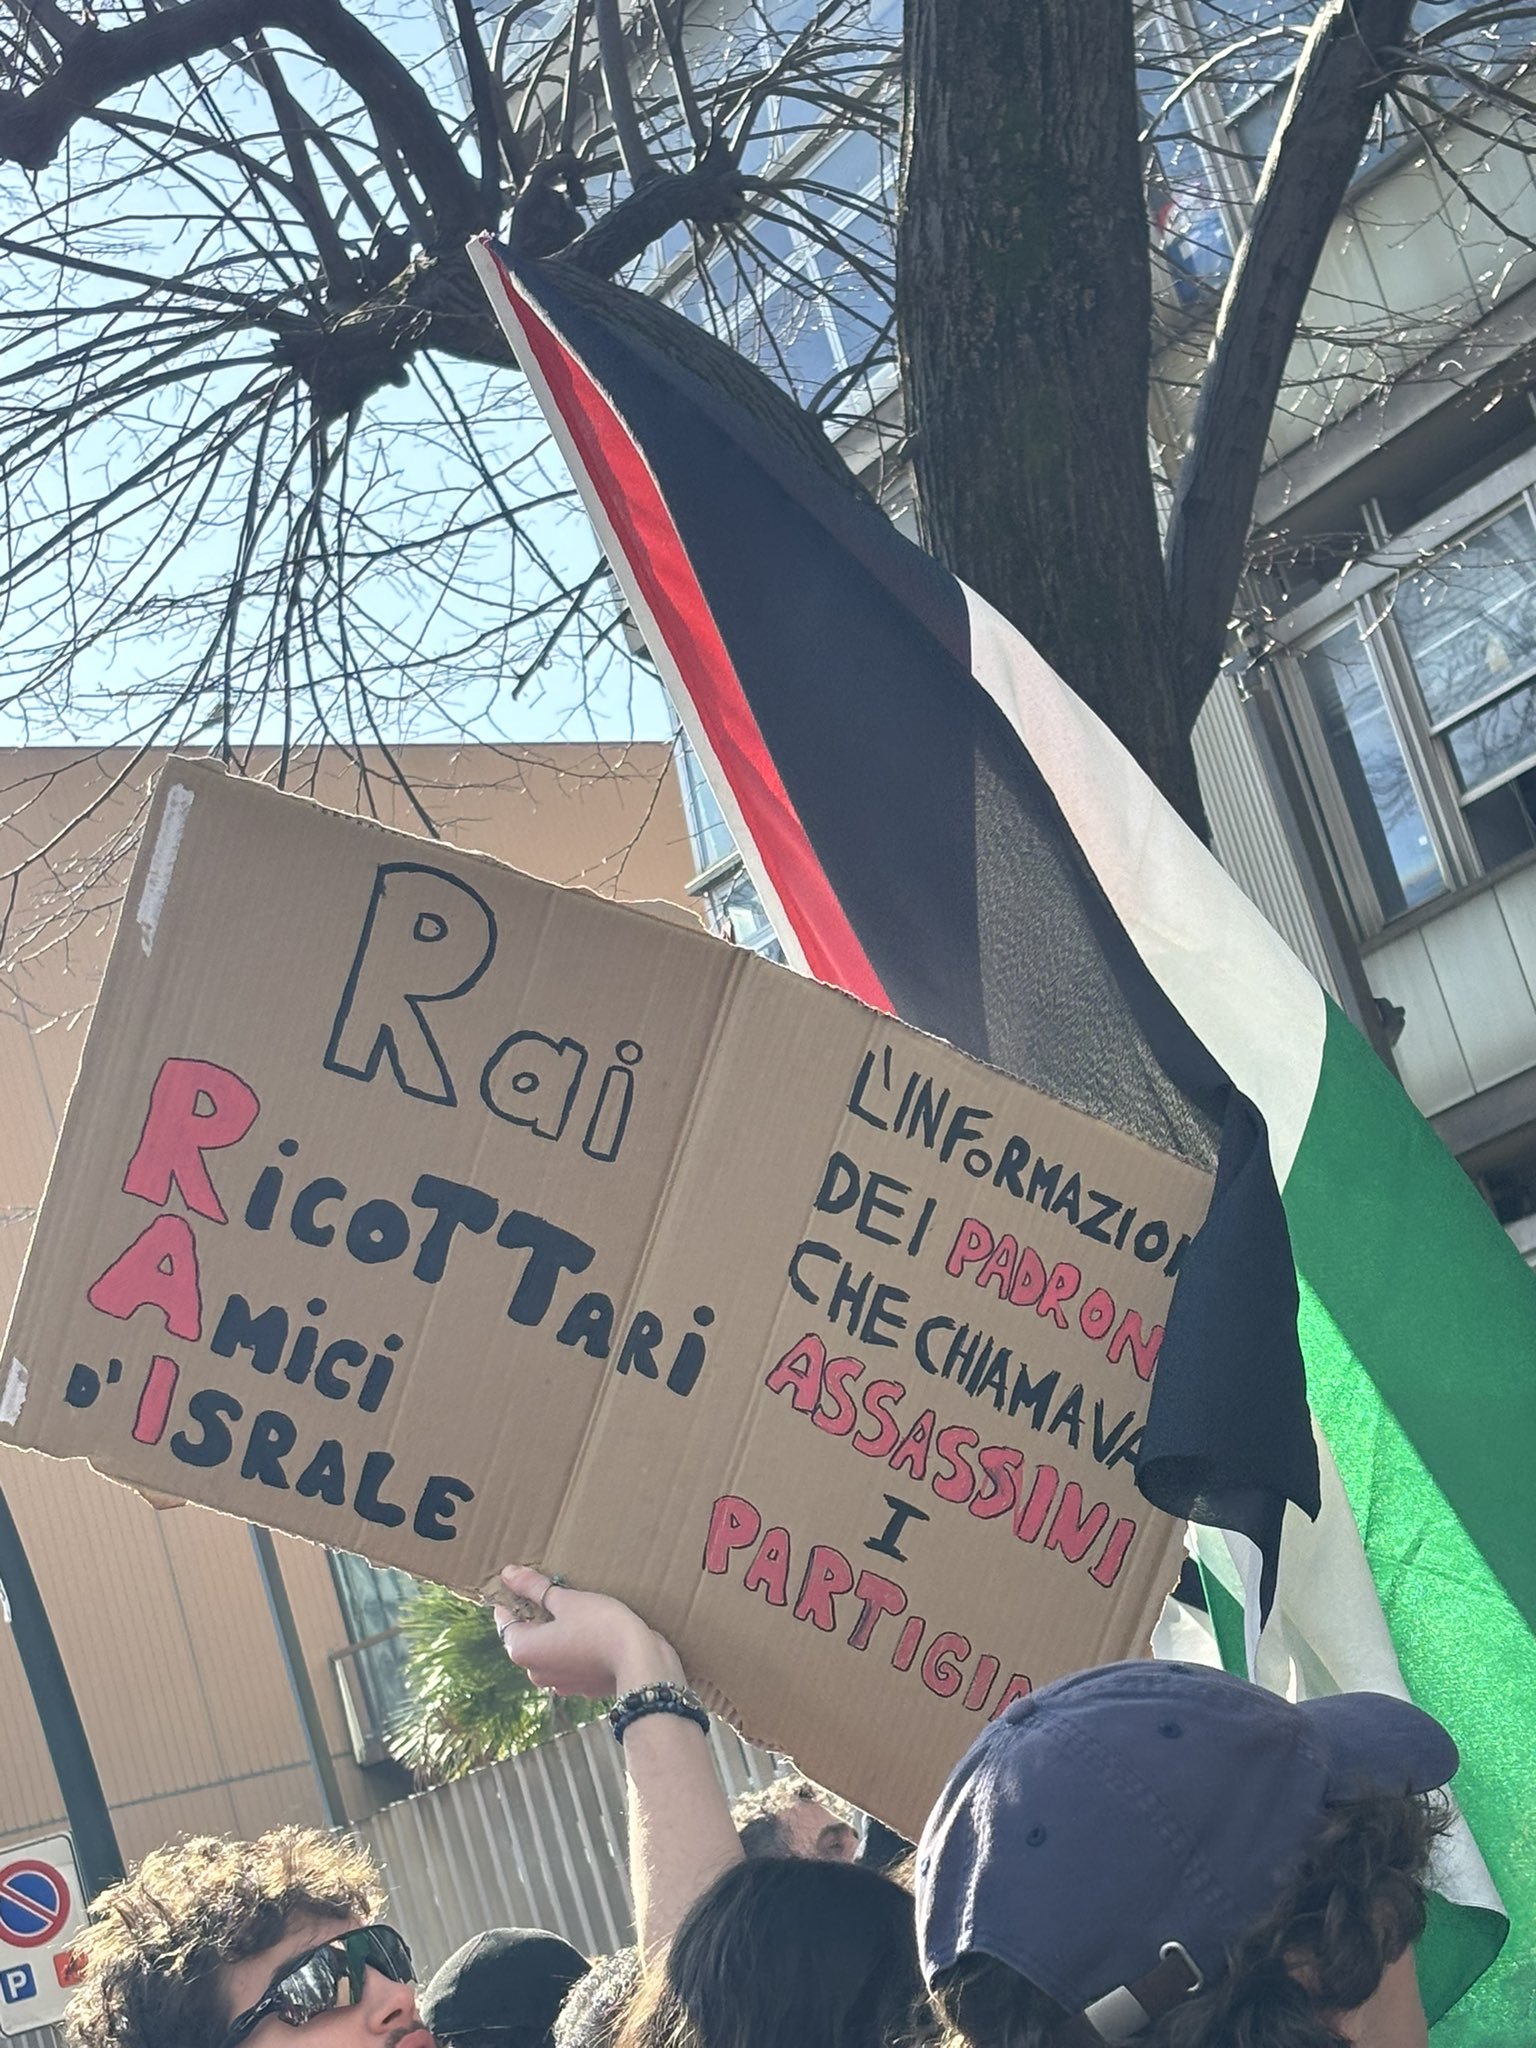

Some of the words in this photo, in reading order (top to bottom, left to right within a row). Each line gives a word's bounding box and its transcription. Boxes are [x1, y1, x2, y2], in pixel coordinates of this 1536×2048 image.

[323, 862, 643, 1162] Rai
[813, 1151, 937, 1257] DEI
[787, 1240, 910, 1348] CHE
[766, 1332, 1136, 1588] ASSASSINI
[863, 1494, 930, 1563] I
[6, 1971, 27, 1999] P
